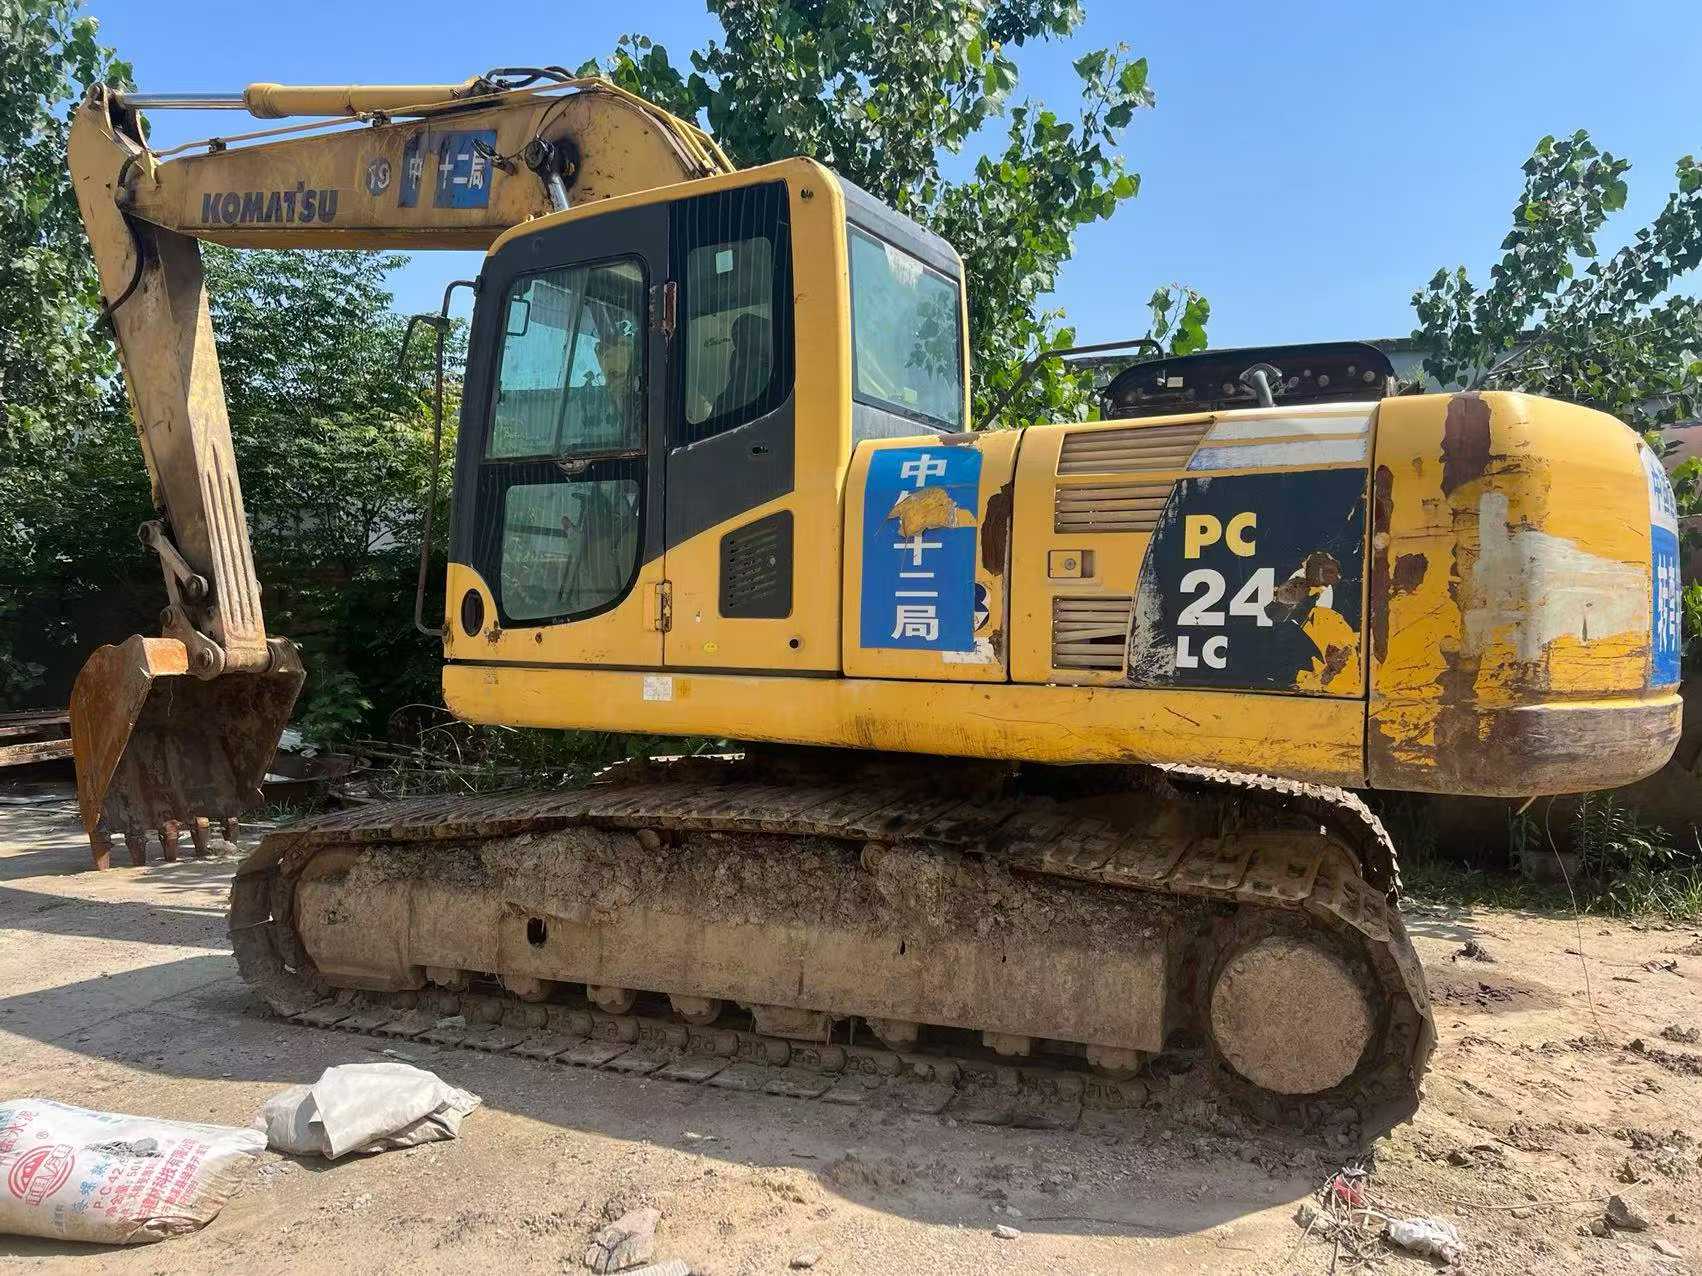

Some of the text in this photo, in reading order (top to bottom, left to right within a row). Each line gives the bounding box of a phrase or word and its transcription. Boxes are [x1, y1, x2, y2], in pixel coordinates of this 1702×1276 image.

[409, 150, 485, 190] 中十二局
[201, 187, 338, 224] KOMATSU
[890, 454, 948, 641] 中十二局
[1184, 511, 1257, 559] PC
[1176, 635, 1229, 669] LC
